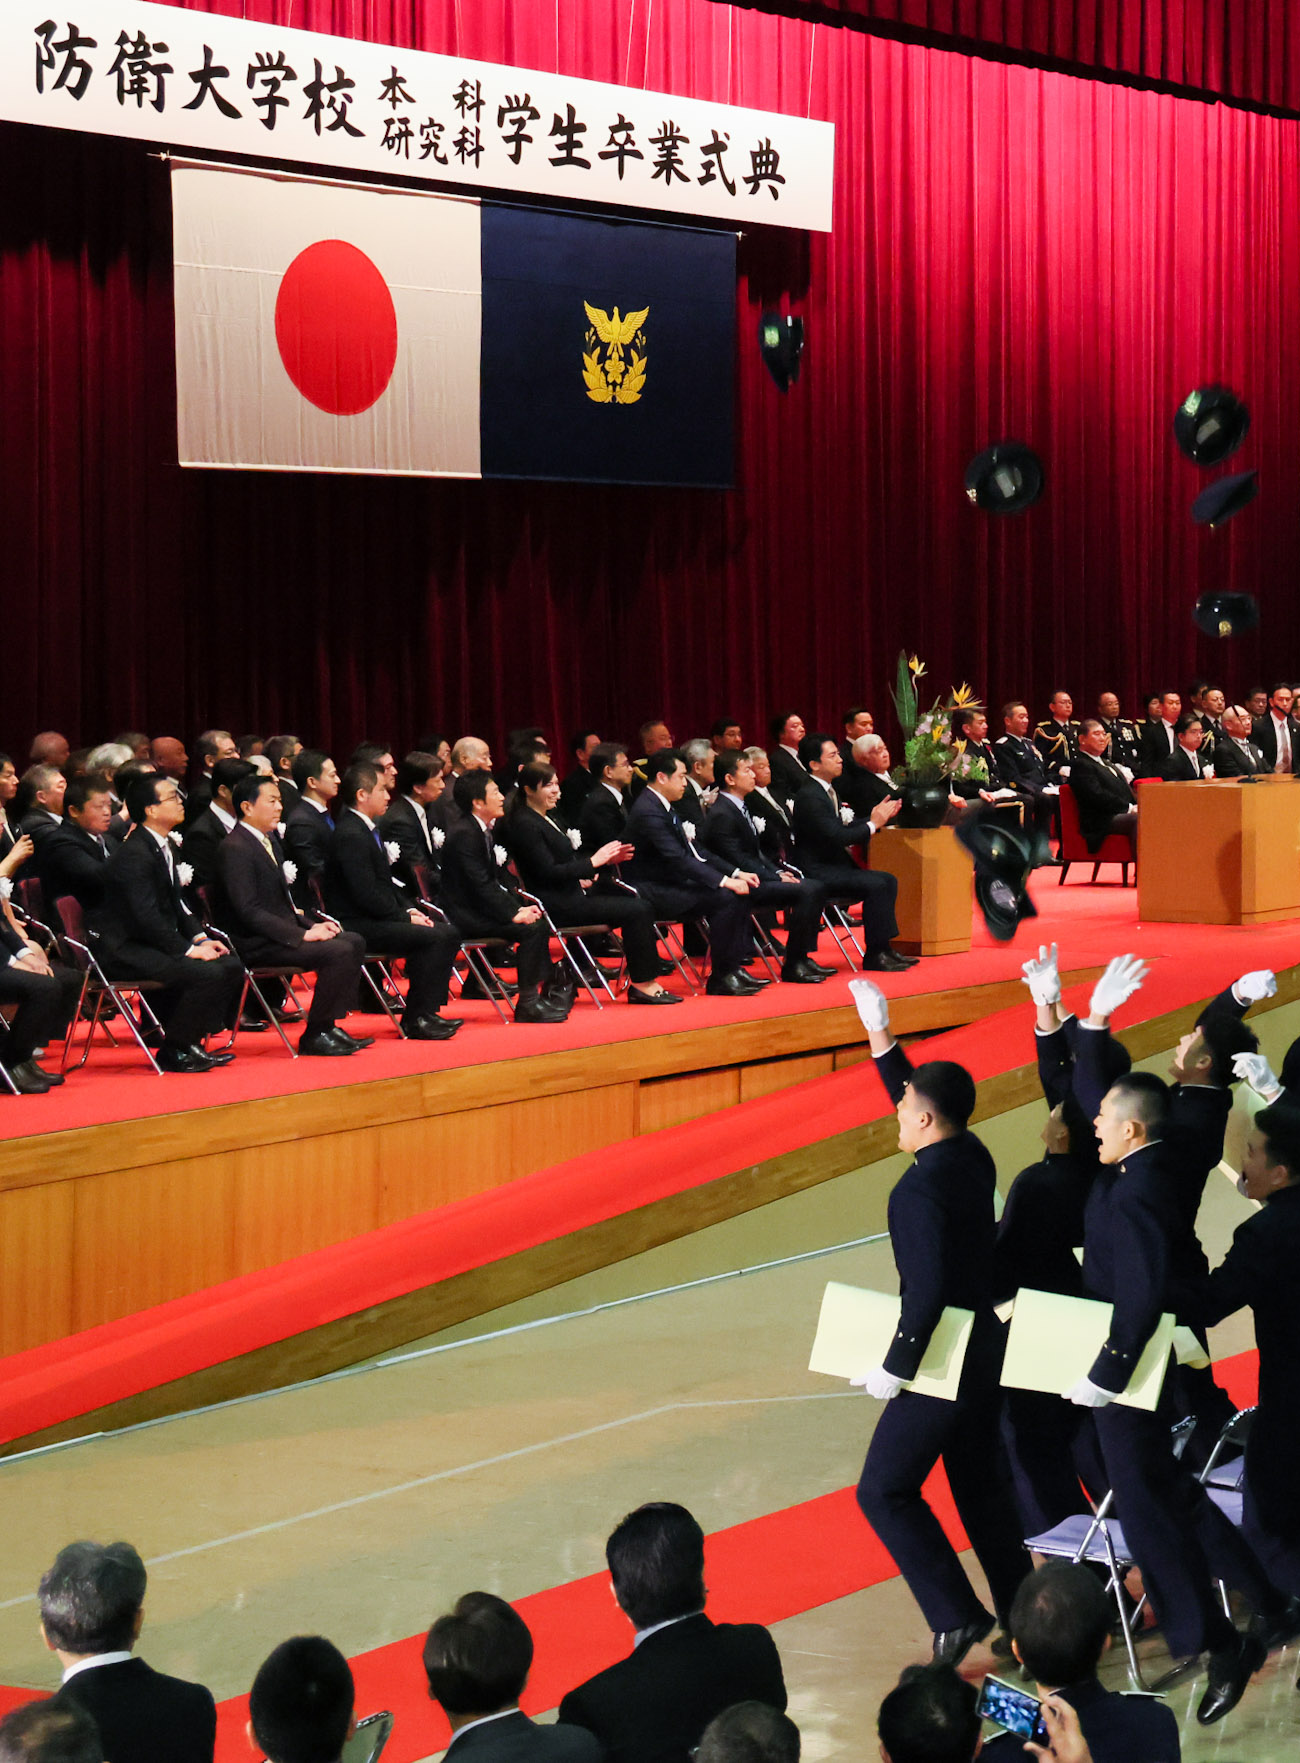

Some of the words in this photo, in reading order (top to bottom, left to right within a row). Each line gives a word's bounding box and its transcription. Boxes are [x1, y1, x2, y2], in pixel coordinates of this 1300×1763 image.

[34, 19, 366, 138] 防衛大学校
[380, 116, 486, 169] 研究科
[497, 93, 786, 201] 学生卒業式典
